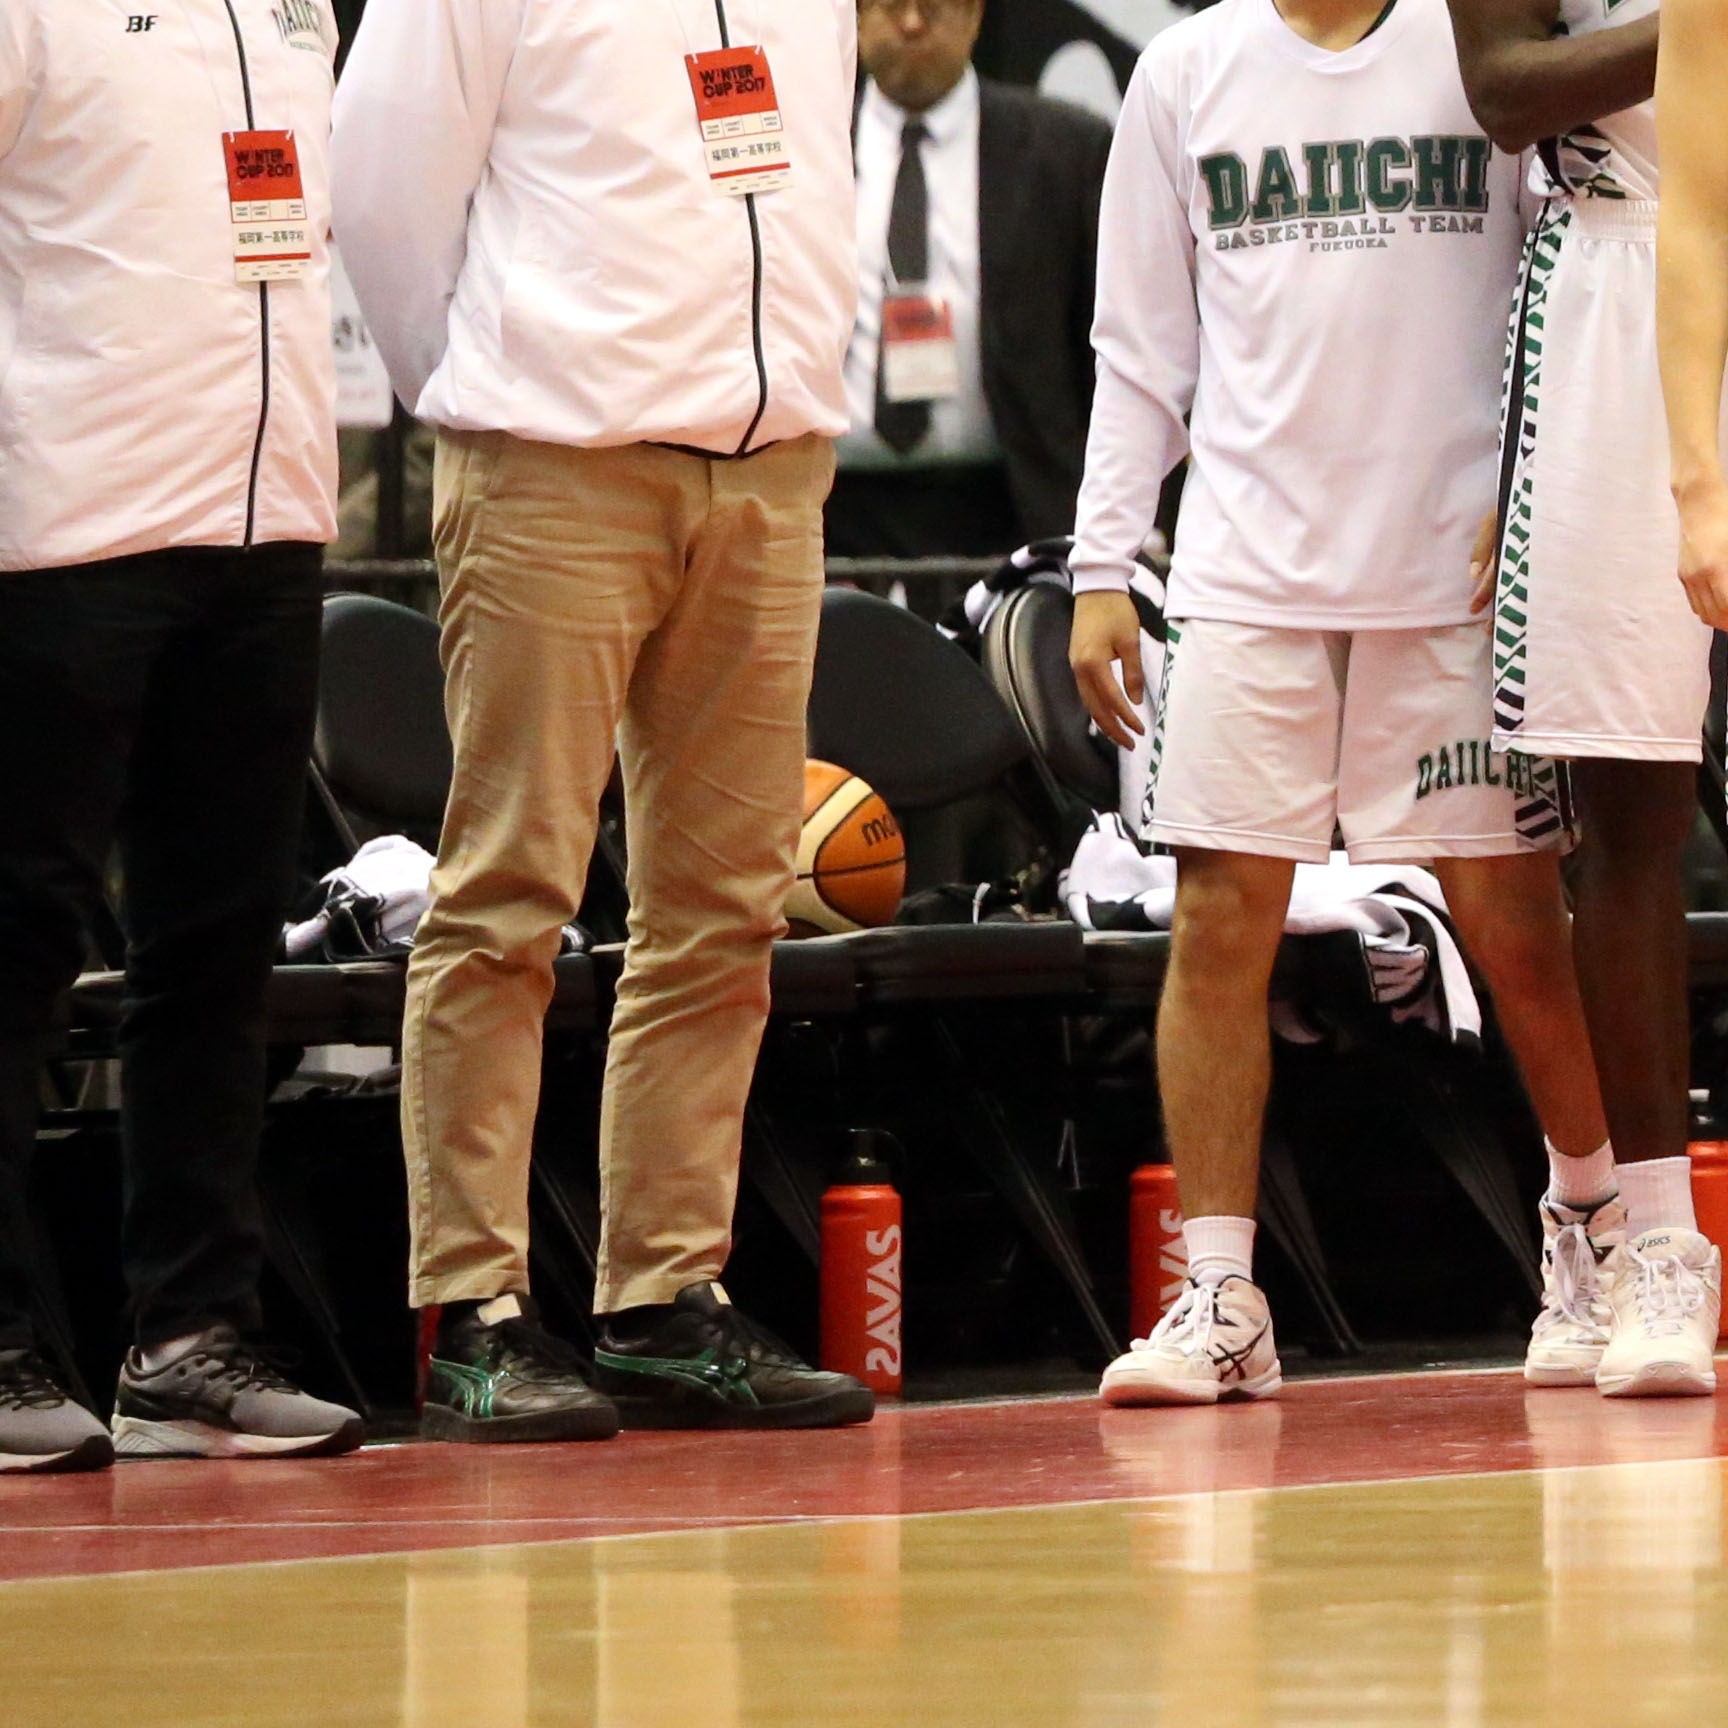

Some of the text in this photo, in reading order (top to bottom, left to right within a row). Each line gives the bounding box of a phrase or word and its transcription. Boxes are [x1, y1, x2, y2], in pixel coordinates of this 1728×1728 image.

[1198, 133, 1491, 230] DAIICHI
[1215, 215, 1485, 251] BASKETBALL TEAM
[1309, 237, 1388, 253] FUKUOKA
[866, 1224, 901, 1376] SAVAS
